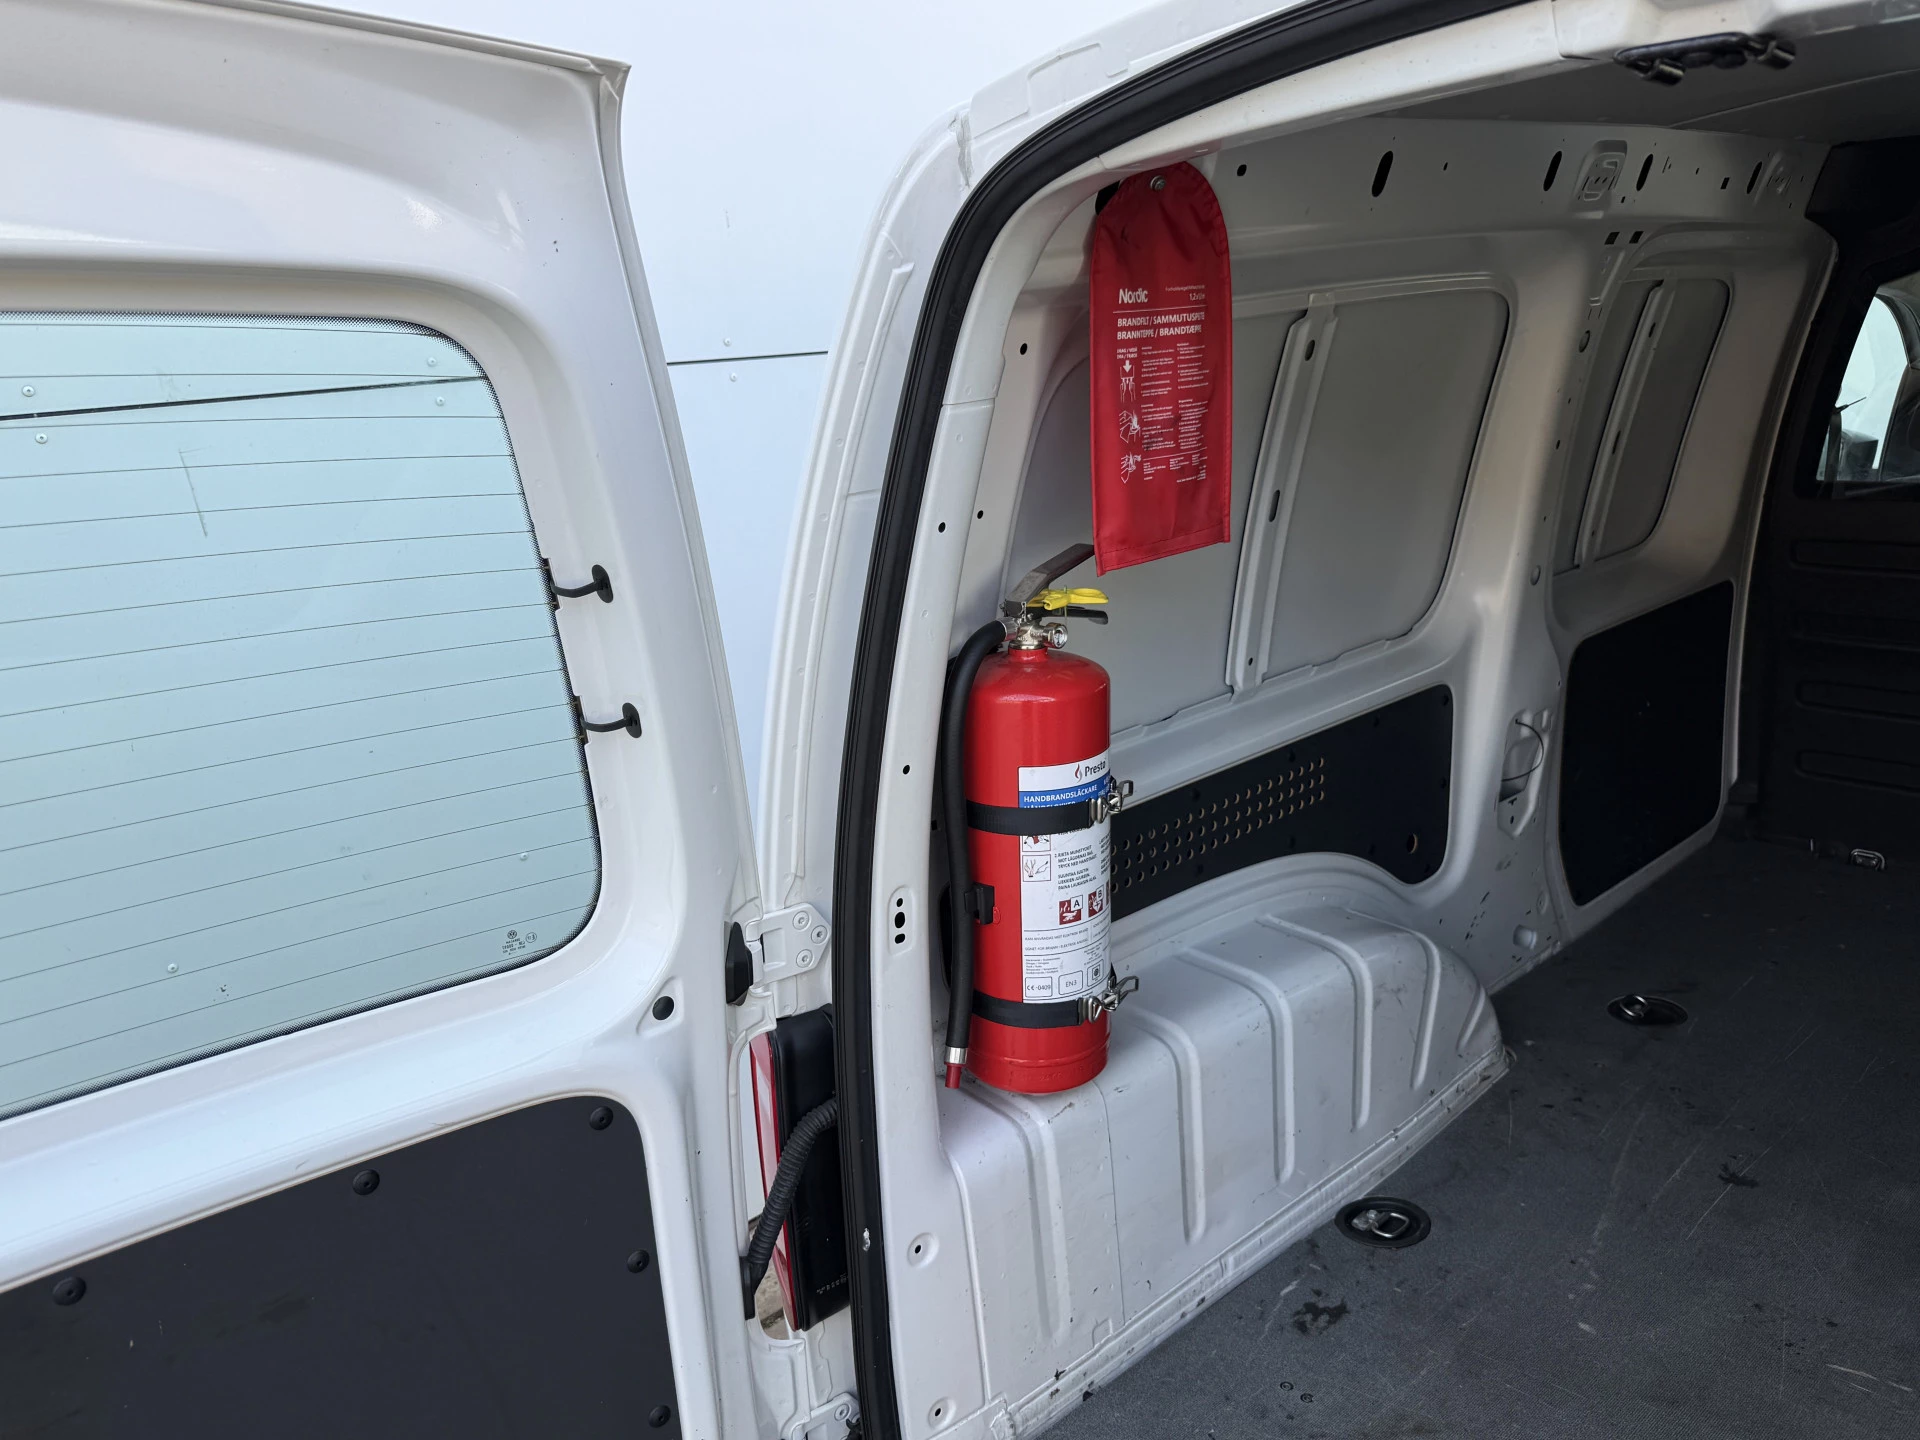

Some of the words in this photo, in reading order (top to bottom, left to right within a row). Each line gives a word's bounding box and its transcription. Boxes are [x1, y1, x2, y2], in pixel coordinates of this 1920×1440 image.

[1118, 288, 1148, 304] Nordic
[1118, 317, 1149, 327] BRANDFILT
[1085, 760, 1106, 777] Presta
[1024, 784, 1098, 802] HANDBRANDSLÄCKARE
[1098, 890, 1102, 898] B
[1073, 899, 1080, 908] A
